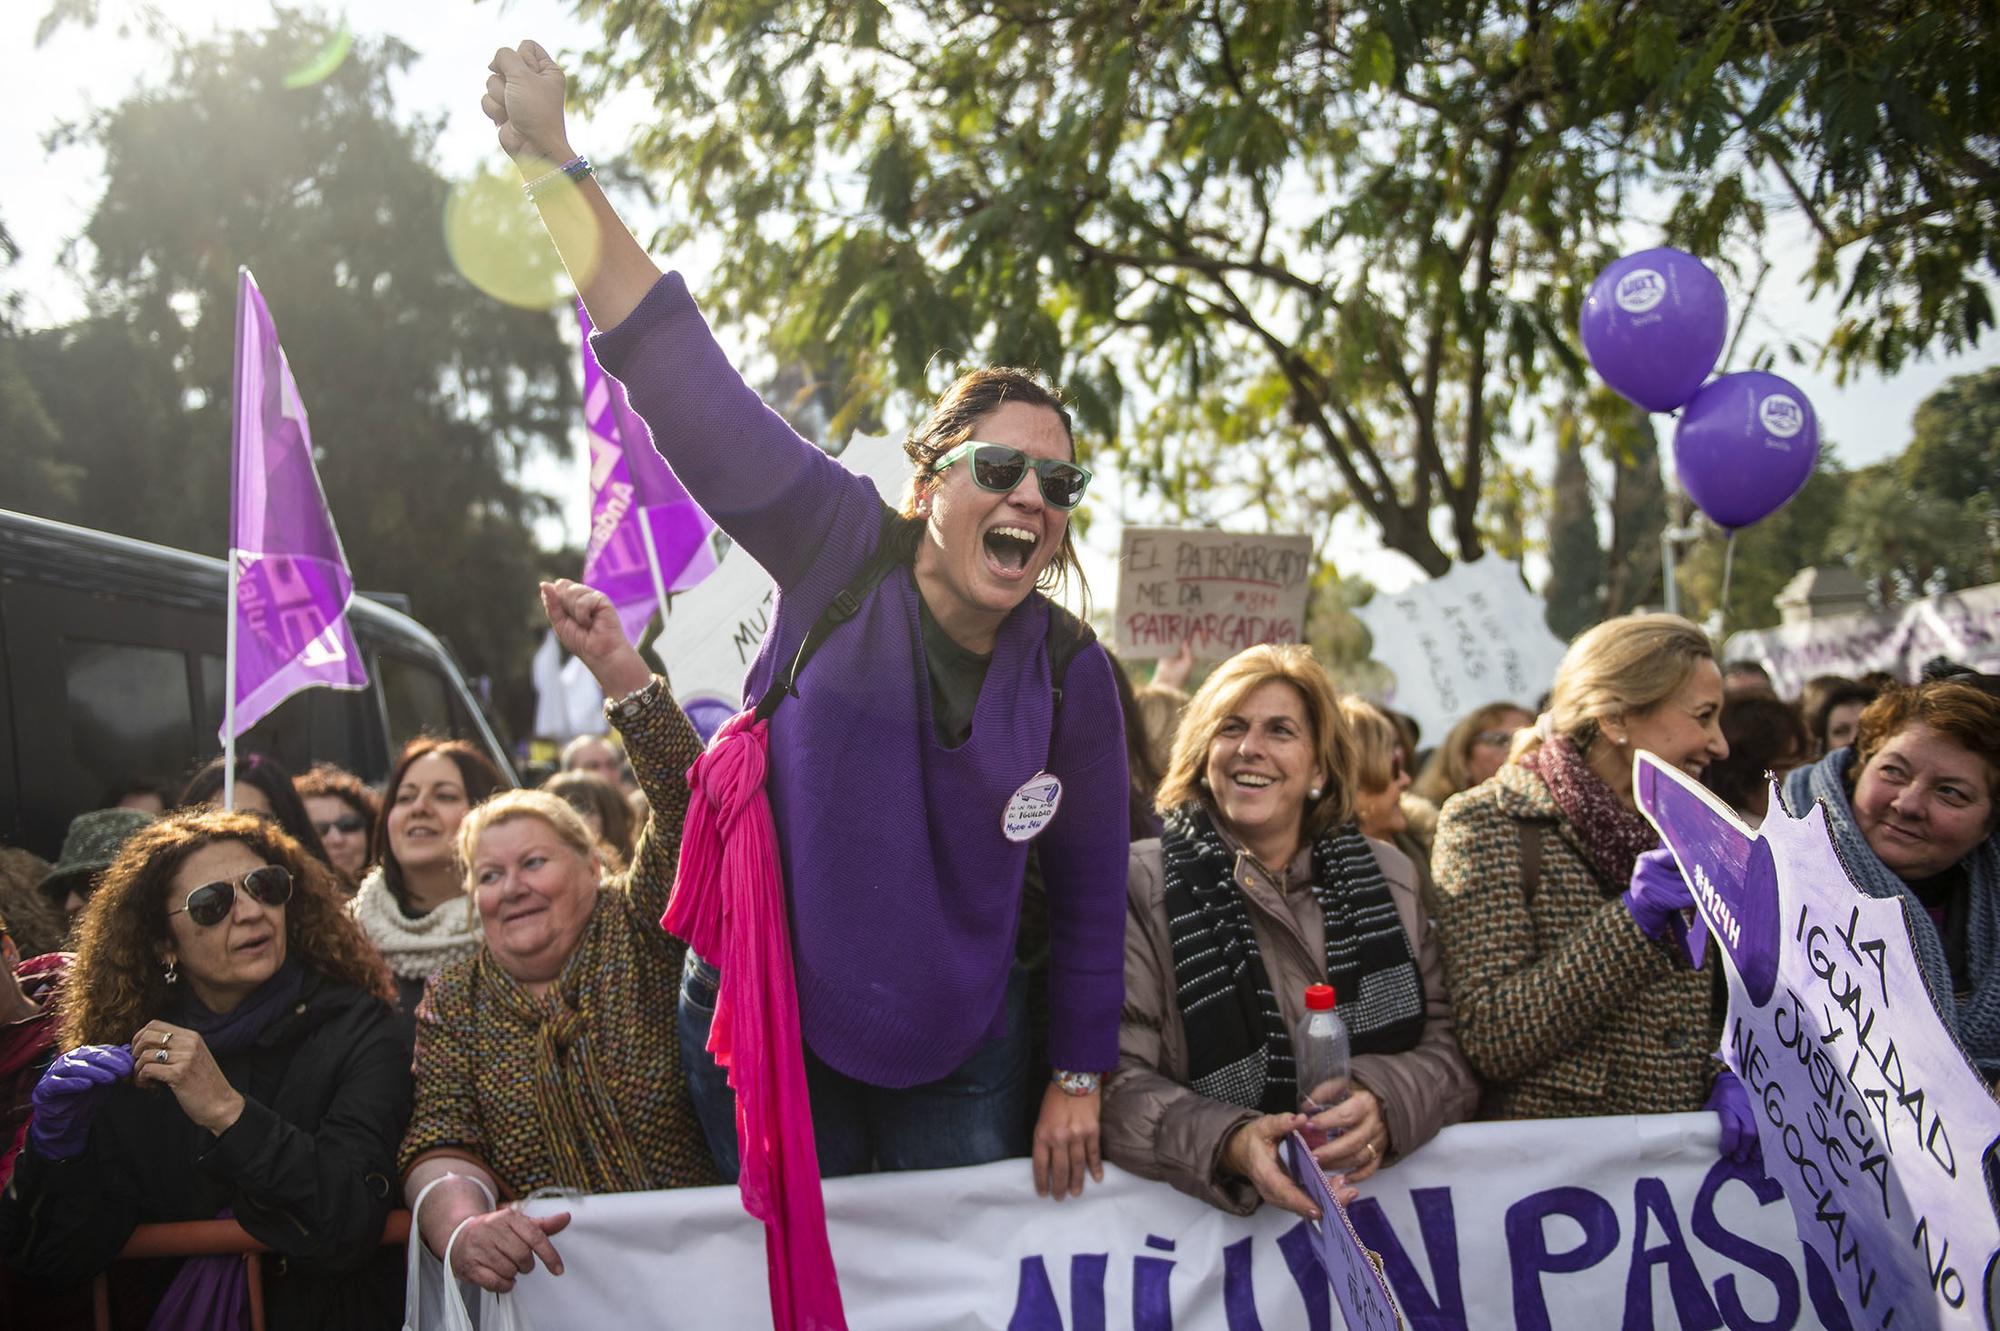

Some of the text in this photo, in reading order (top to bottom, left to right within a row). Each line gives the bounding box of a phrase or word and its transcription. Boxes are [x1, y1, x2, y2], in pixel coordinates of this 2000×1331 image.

[1128, 537, 1161, 571] EL
[1136, 580, 1169, 607] ME
[1178, 583, 1202, 606] DA
[1019, 810, 1051, 819] IGUALDAD
[1796, 904, 1957, 1179] IGUALDAD
[1820, 1003, 1894, 1156] Y LA
[1774, 988, 1965, 1309] JUSTICIA NO
[1806, 1101, 1853, 1187] SE
[1505, 1157, 1850, 1331] PAS
